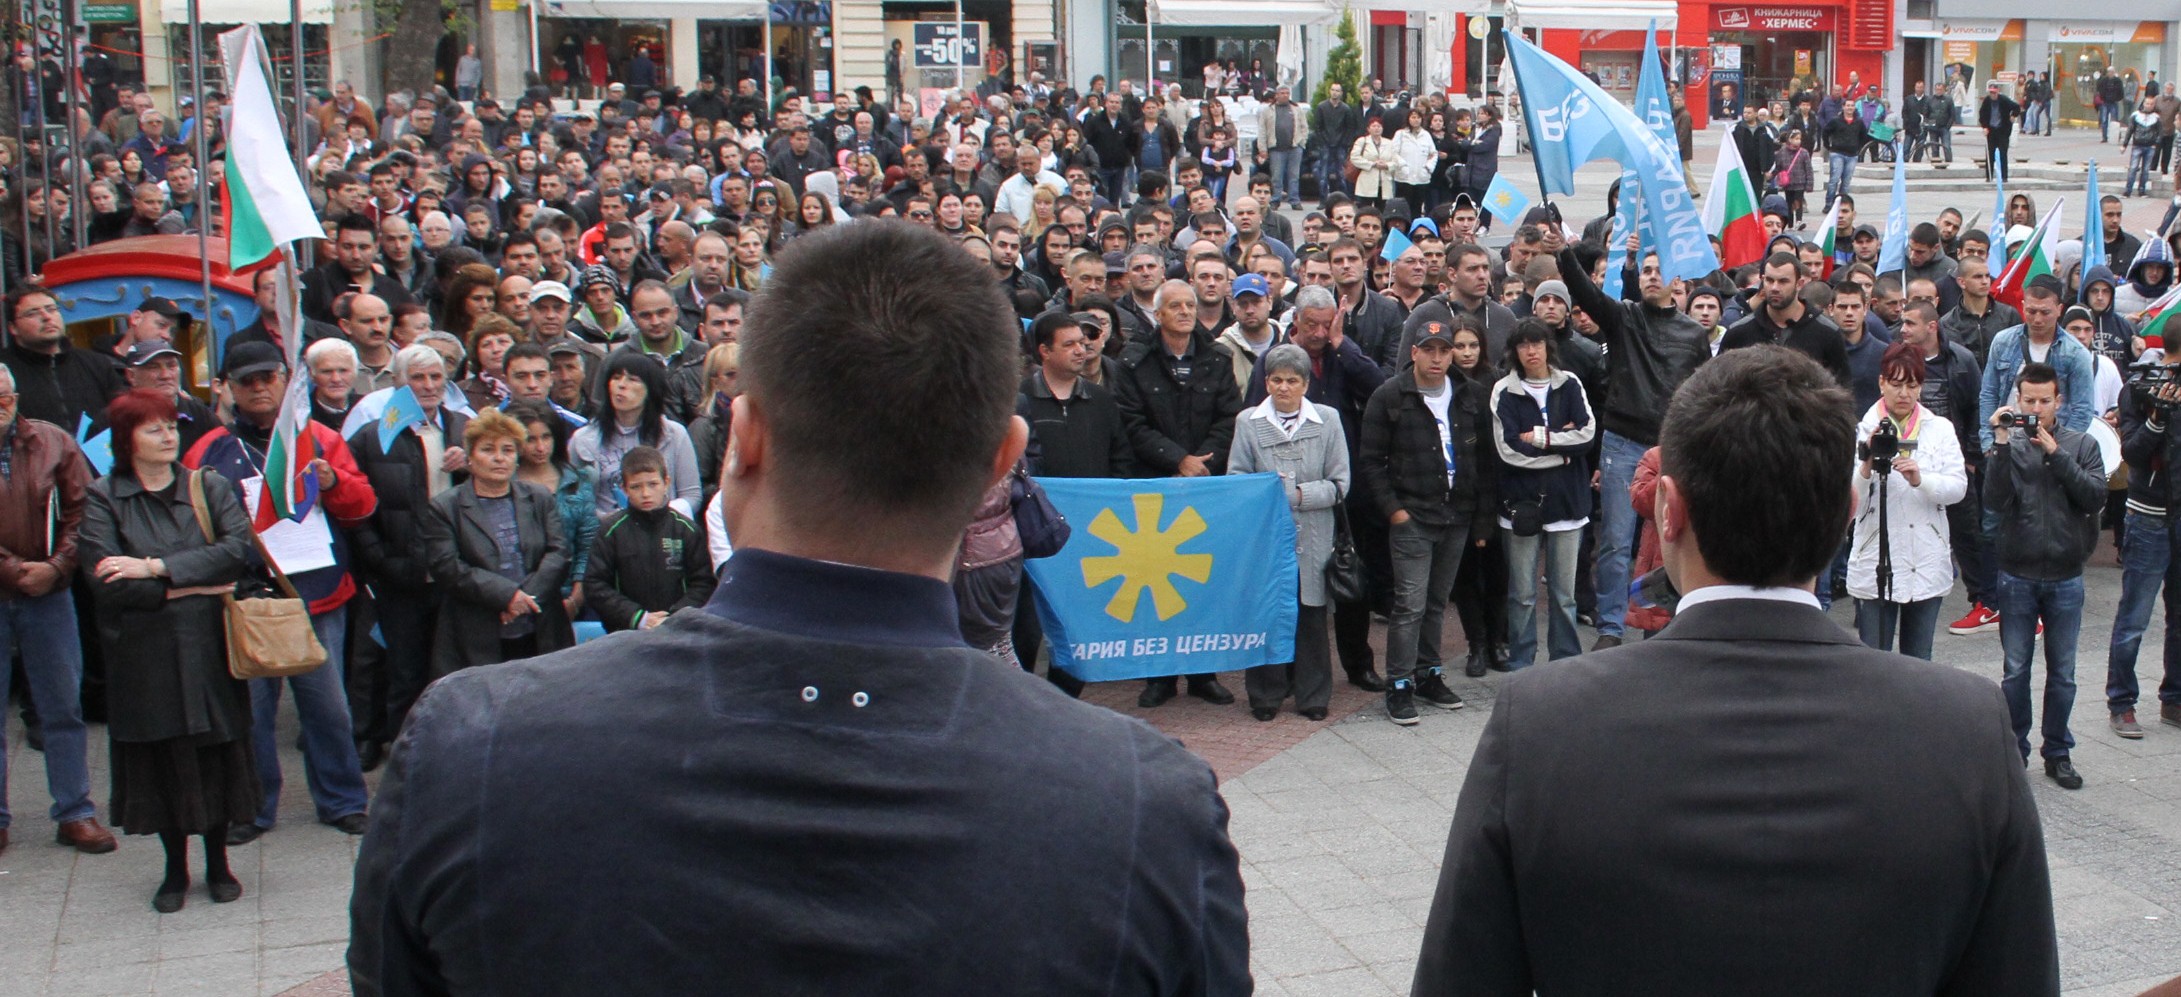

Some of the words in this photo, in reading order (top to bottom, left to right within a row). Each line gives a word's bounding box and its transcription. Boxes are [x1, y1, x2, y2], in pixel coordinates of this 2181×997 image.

[1754, 8, 1822, 17] КНИЖАРНИЦА
[2072, 28, 2114, 36] VIVACOM
[1132, 636, 1168, 657] БЕЗ
[1176, 632, 1266, 655] ЦЕНЗУРА
